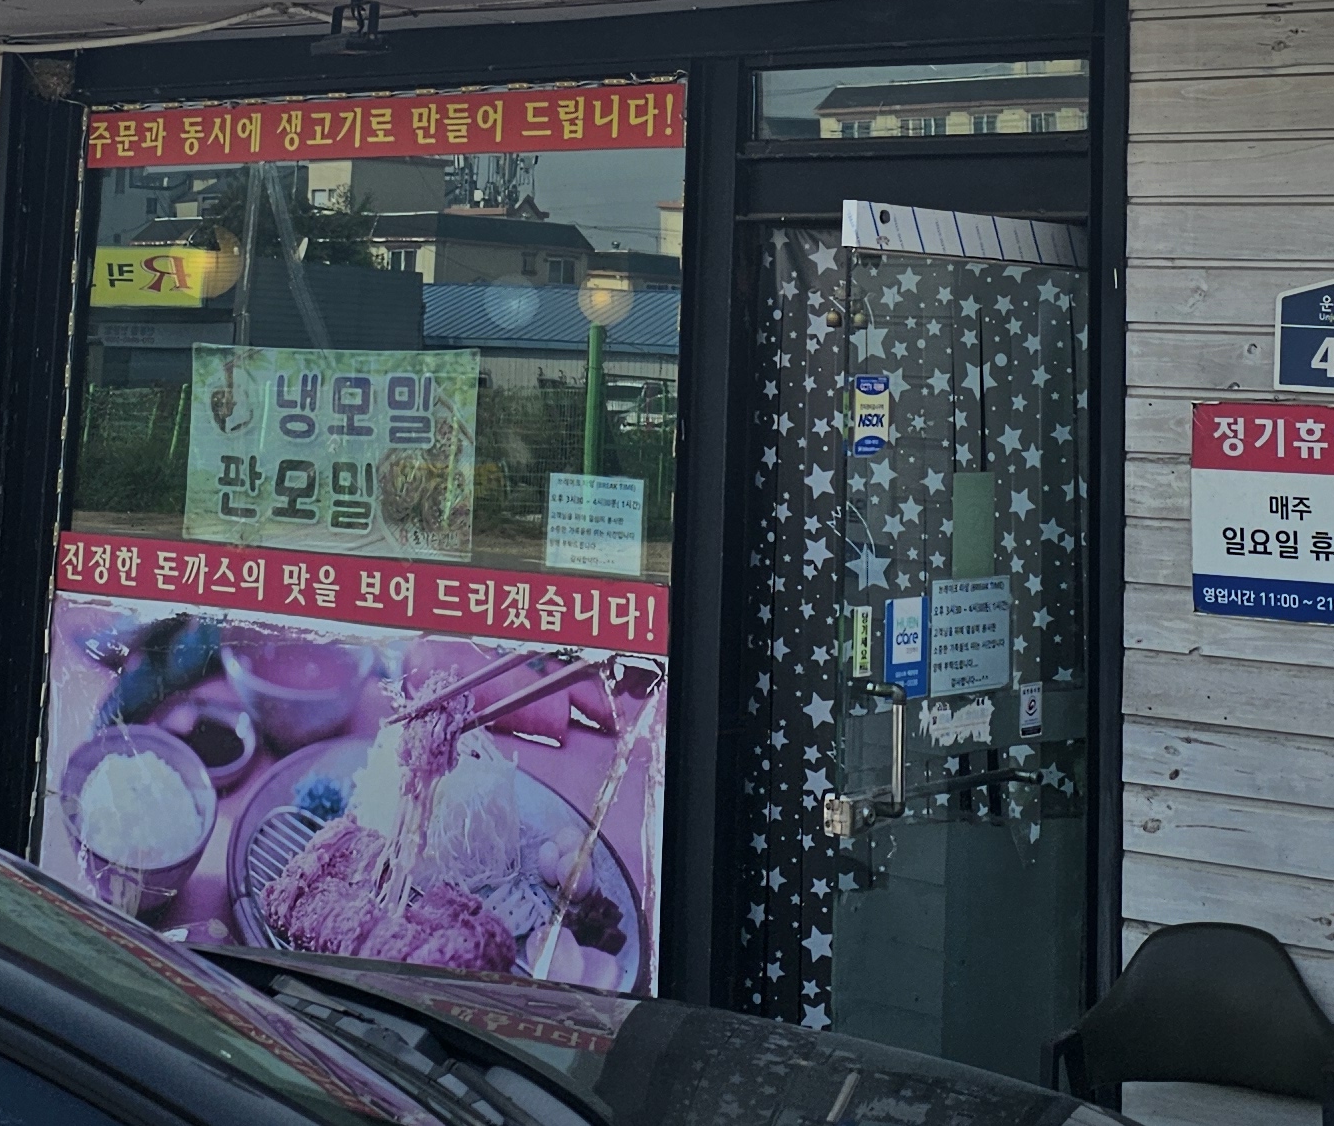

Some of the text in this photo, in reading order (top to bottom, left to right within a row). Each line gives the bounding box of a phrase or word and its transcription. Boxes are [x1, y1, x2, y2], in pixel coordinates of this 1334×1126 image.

[89, 93, 674, 159] 주문과 동시에 생고기로 만들어 드립니다!
[275, 374, 432, 444] 냉모밀
[218, 454, 375, 531] 판모밀
[1269, 495, 1312, 521] 매주
[1222, 528, 1299, 560] 일요일
[61, 541, 656, 641] 진정한 돈까스의 맛을 보여 드리겠습니다!
[1203, 588, 1255, 606] 영업시간
[1259, 590, 1299, 608] 11:00
